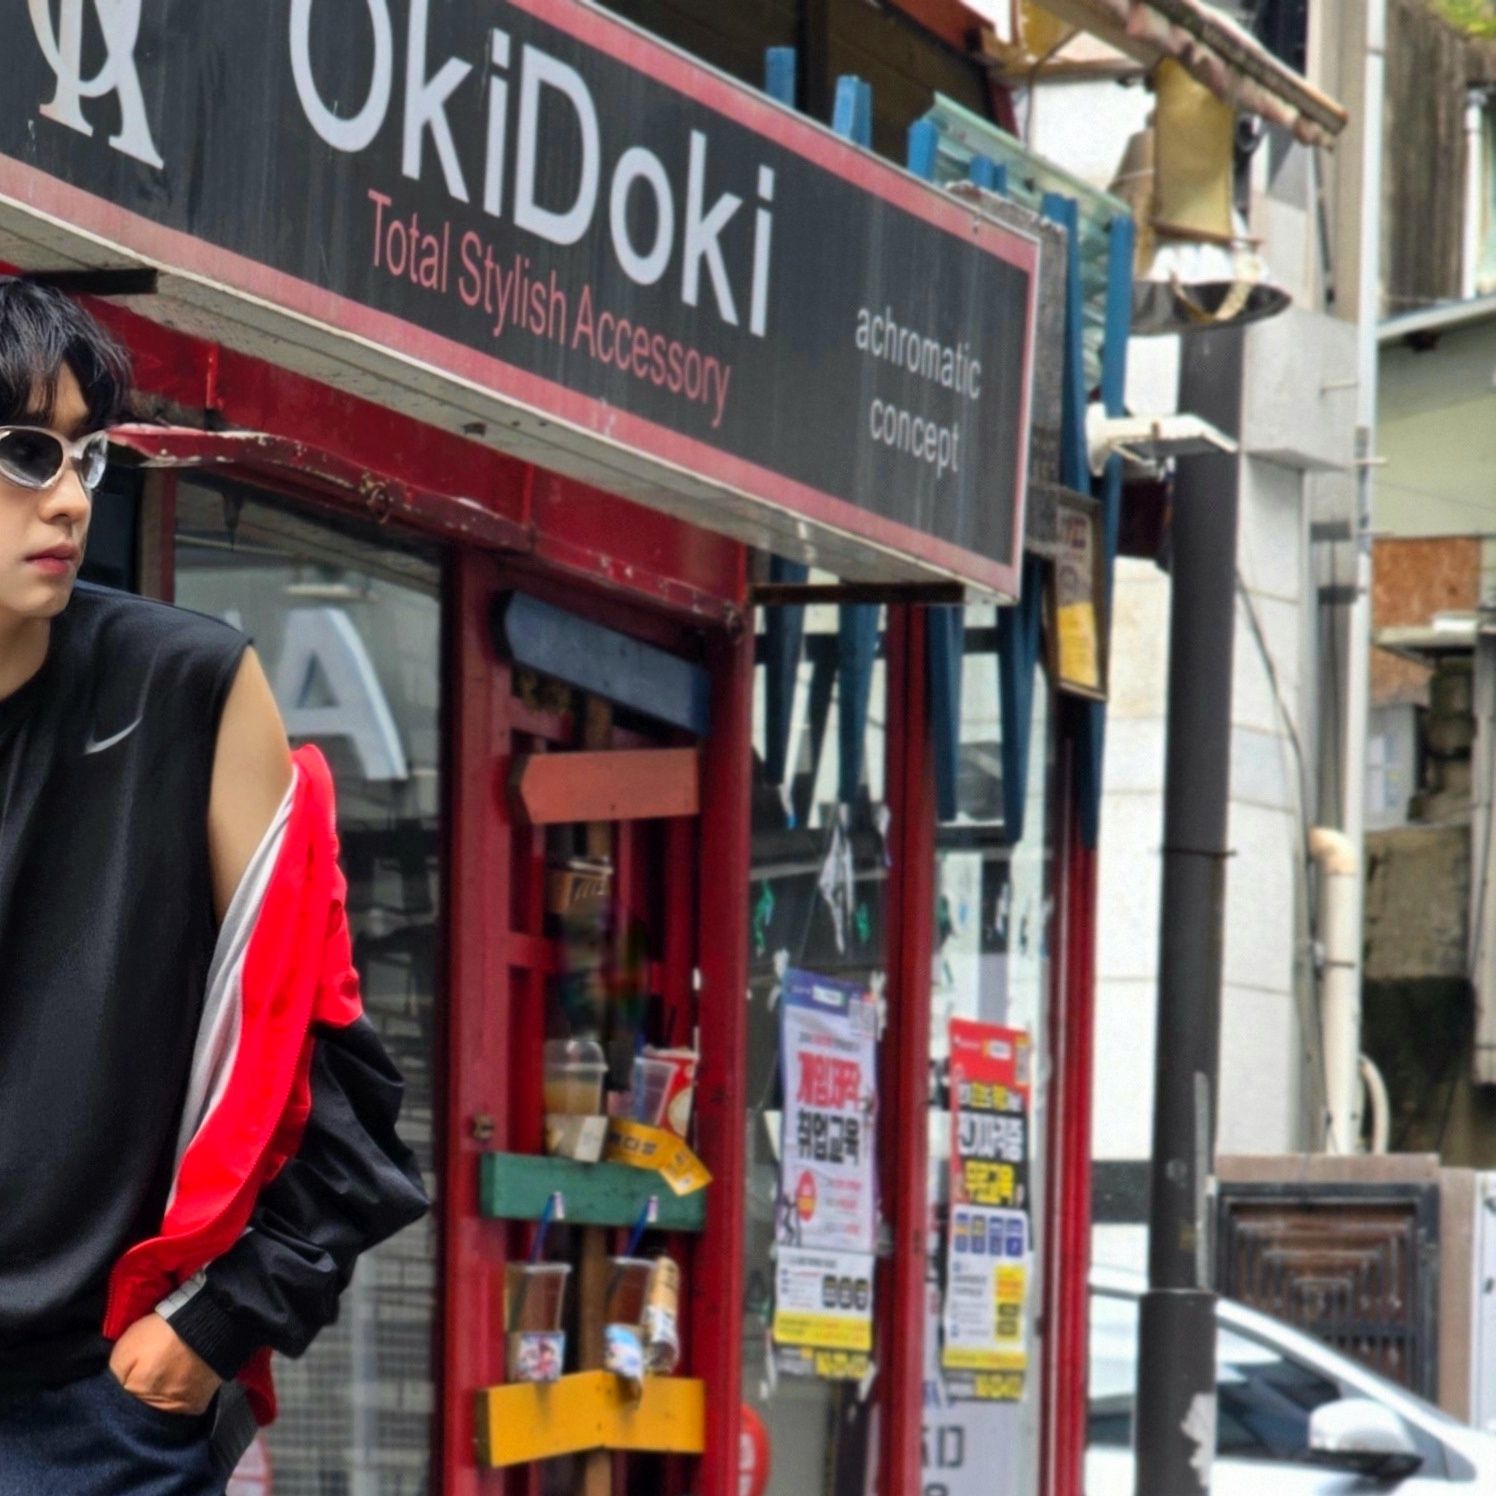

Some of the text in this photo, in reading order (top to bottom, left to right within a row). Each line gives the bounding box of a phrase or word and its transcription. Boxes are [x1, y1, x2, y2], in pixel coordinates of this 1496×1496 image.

[289, 0, 774, 337] OkiDoki
[368, 189, 731, 428] Total Stylish Accessory
[855, 304, 982, 400] achromatic
[870, 397, 959, 480] concept
